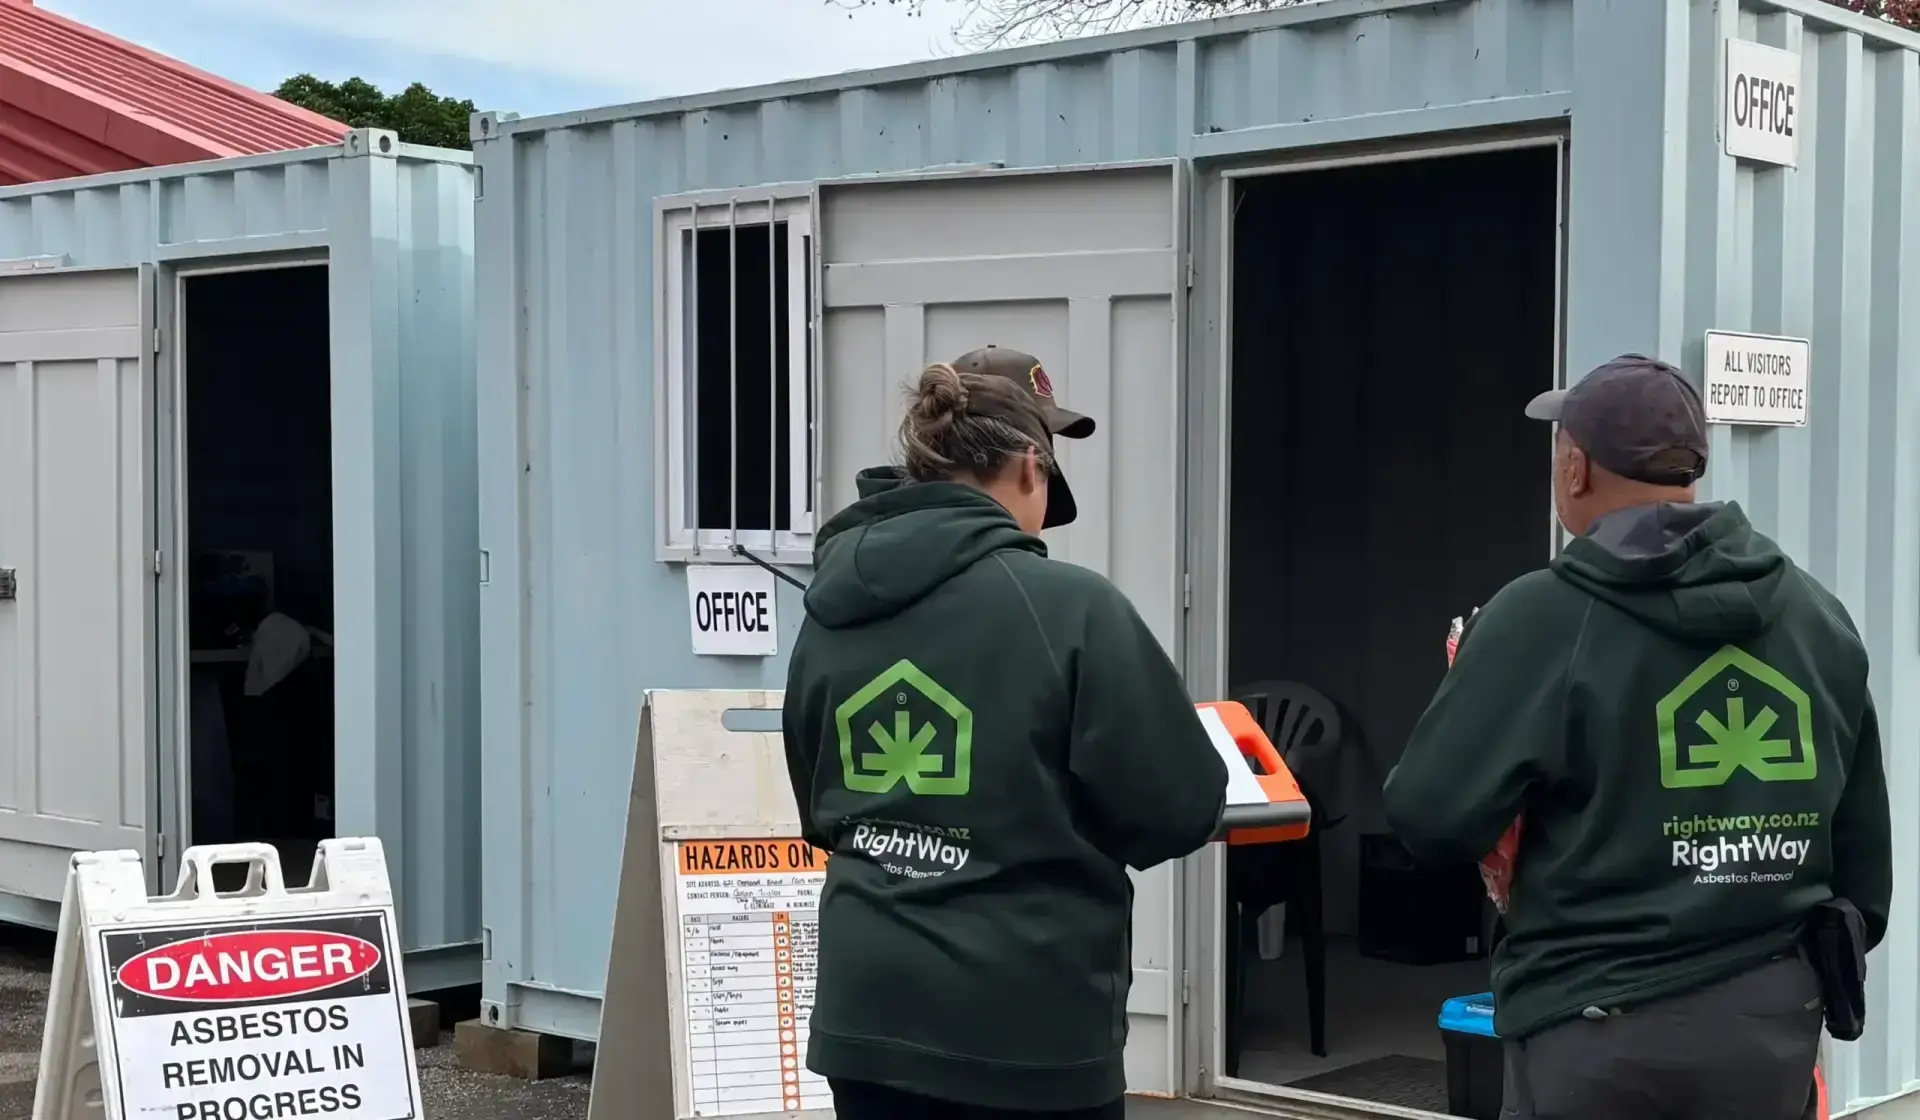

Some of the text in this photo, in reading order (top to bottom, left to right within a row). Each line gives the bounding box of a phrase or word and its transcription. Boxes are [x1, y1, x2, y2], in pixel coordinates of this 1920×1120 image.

[1734, 73, 1795, 137] OFFICE
[1724, 350, 1792, 376] ALL VISITORS
[1710, 383, 1803, 410] REPORT TO OFFICE
[696, 591, 769, 632] OFFICE
[1663, 812, 1820, 840] rightway.co.nz
[685, 844, 779, 870] HAZARDS
[788, 843, 815, 868] ON
[852, 825, 970, 871] RightWay
[1671, 833, 1811, 872] RightWay
[1693, 870, 1794, 885] Asbestos Removal
[146, 942, 355, 991] DANGER
[170, 1004, 349, 1047] ASBESTOS
[162, 1043, 365, 1089] REMOVAL IN
[177, 1084, 362, 1120] PROGRESS
